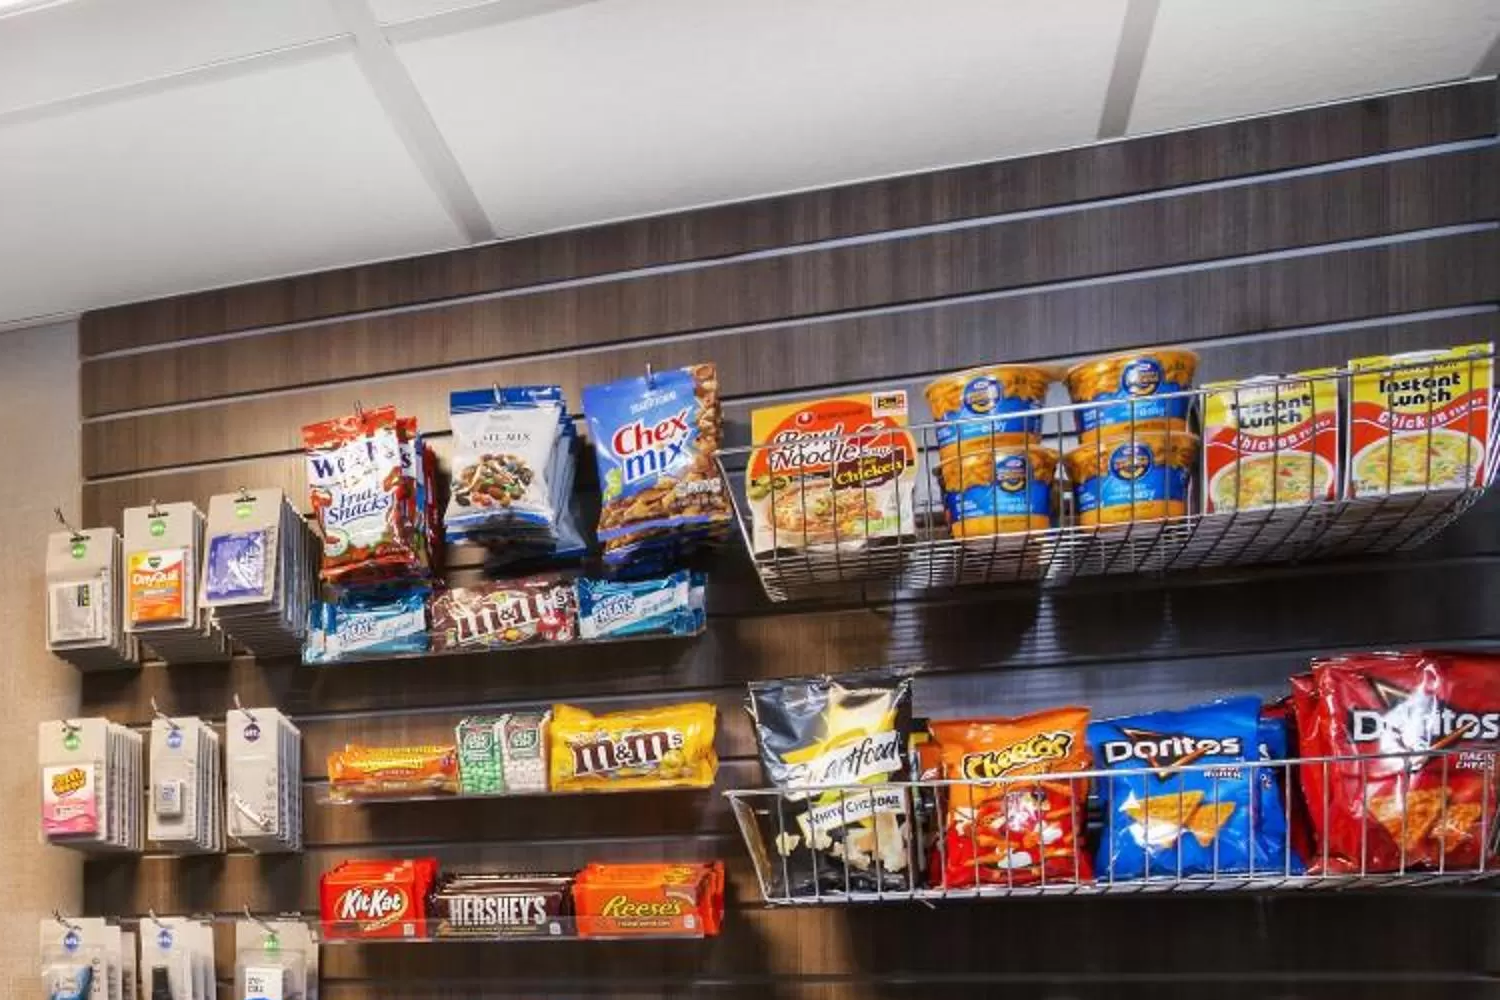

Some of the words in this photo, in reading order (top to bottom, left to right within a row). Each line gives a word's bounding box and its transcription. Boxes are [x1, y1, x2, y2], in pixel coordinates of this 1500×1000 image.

[1379, 371, 1461, 393] Instant
[613, 409, 688, 455] Chex
[1377, 411, 1449, 429] Chickn
[623, 433, 686, 481] mix
[328, 496, 390, 521] Snacks
[1353, 707, 1500, 741] Ditos
[1104, 736, 1241, 764] Doritos
[449, 894, 547, 926] HERSHEY'S
[602, 895, 682, 917] Reese's
